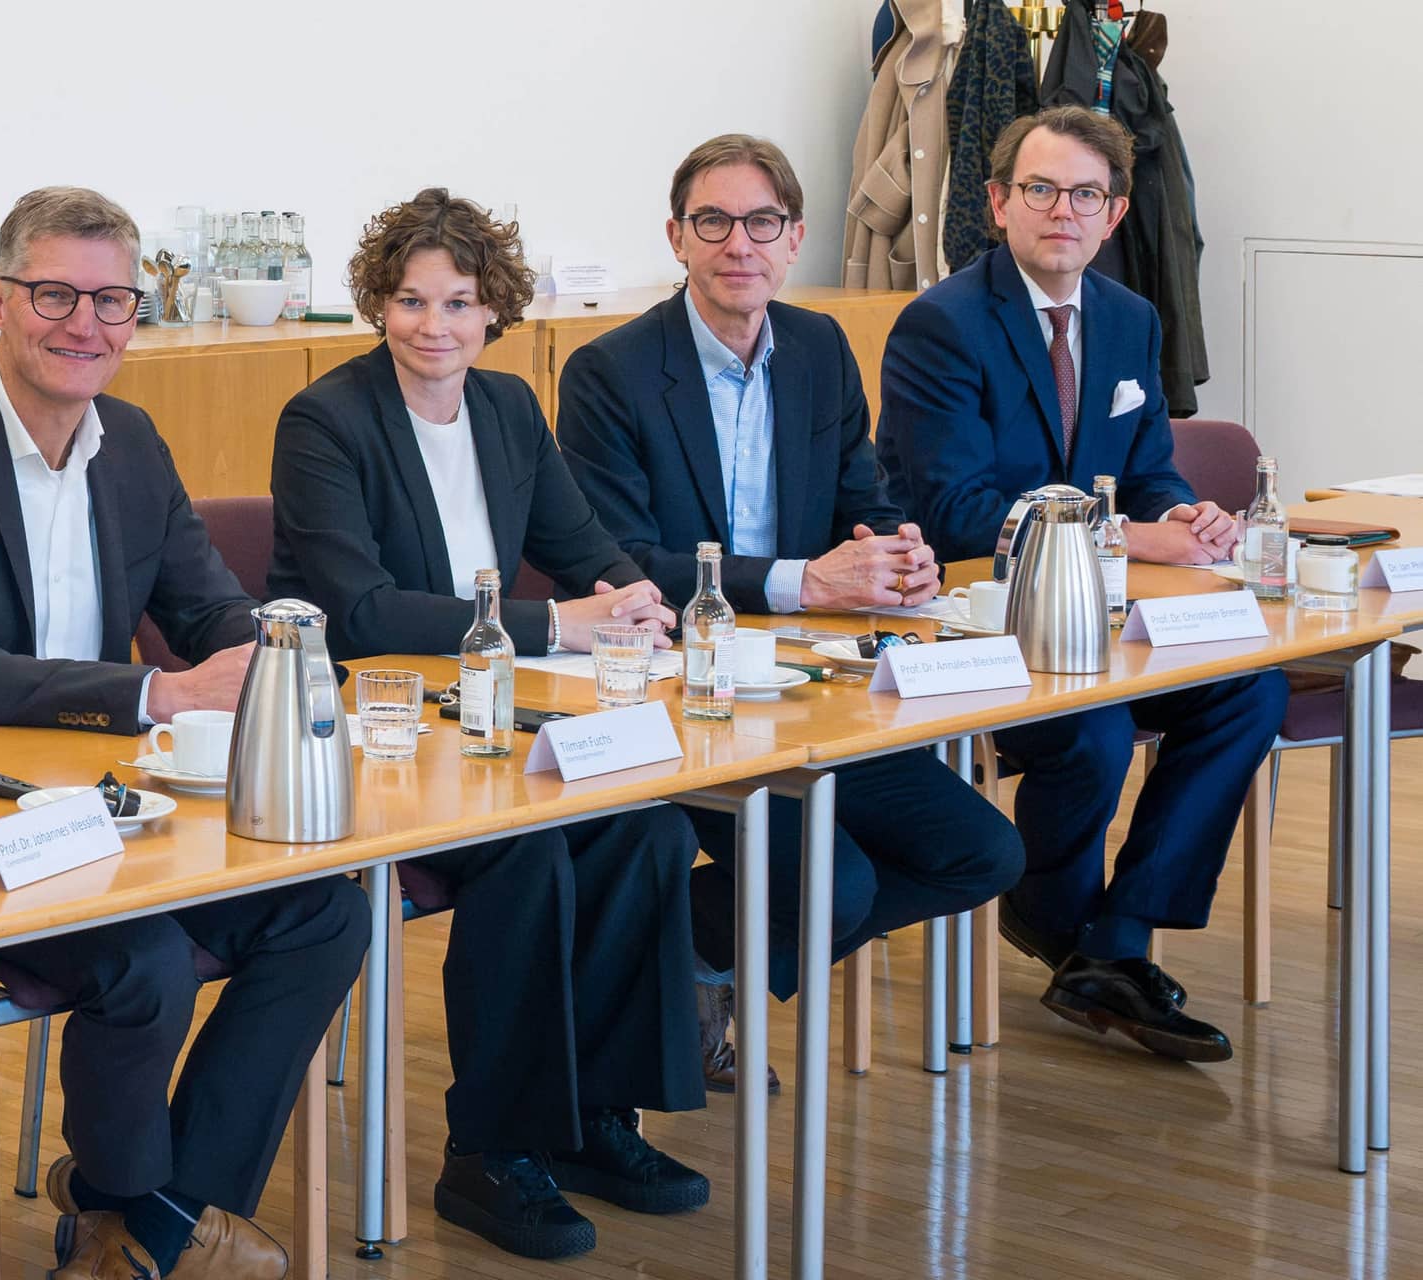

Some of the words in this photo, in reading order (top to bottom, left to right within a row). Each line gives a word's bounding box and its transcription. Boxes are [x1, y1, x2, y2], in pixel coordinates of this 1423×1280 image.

[900, 663, 922, 675] Prof.
[922, 662, 935, 673] Dr.
[19, 836, 33, 850] Dr.
[32, 826, 70, 847] Johannes
[68, 813, 106, 833] Wessling
